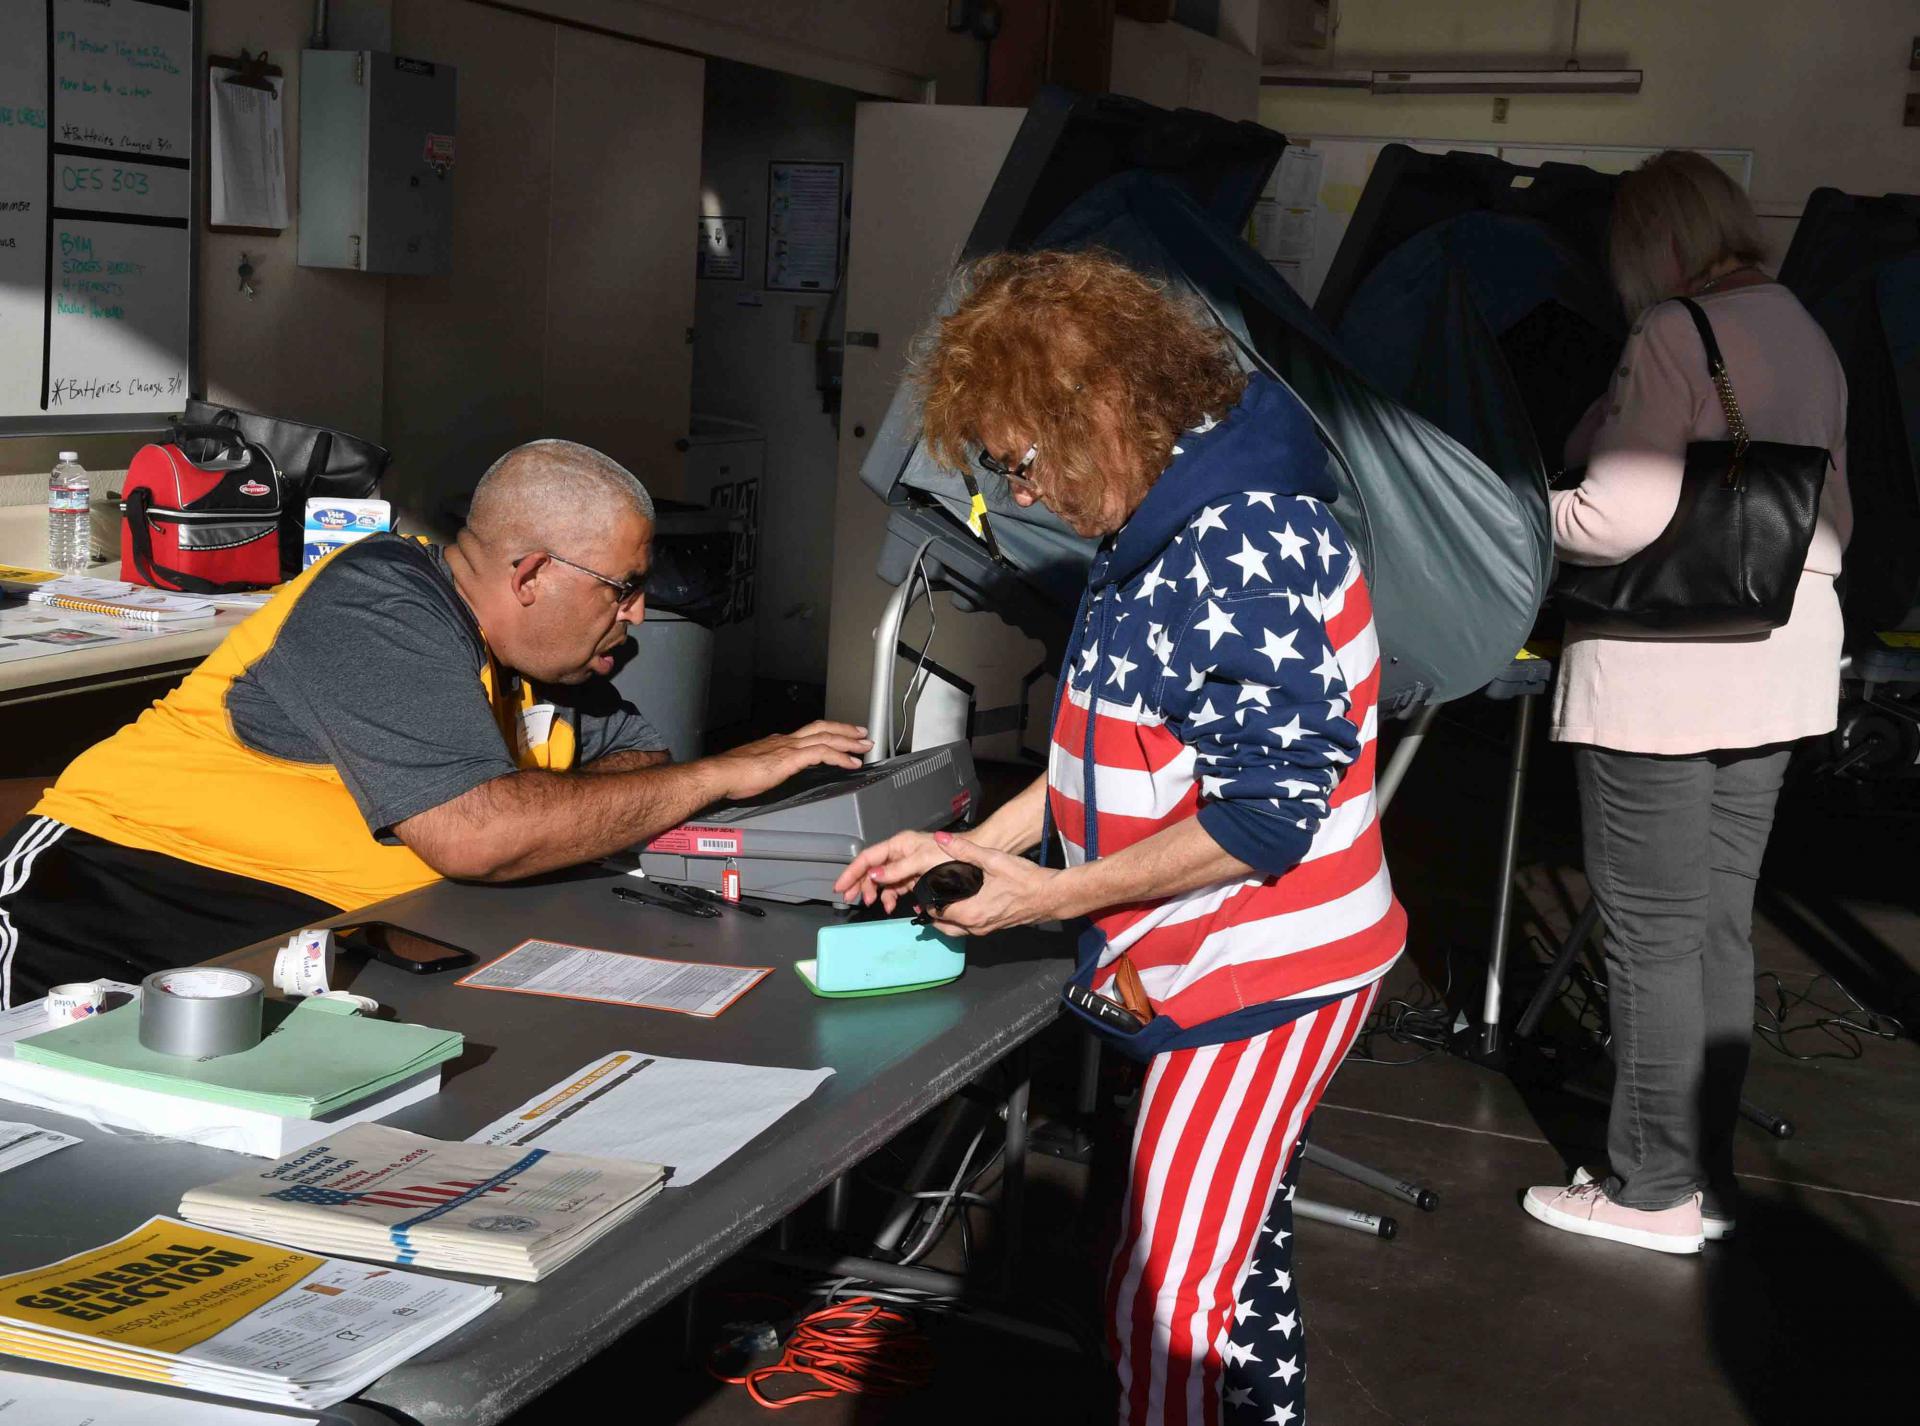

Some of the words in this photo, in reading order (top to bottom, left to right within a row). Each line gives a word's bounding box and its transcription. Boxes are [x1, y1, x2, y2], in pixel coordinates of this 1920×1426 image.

[112, 168, 149, 195] 303
[320, 516, 348, 525] Wipes
[327, 511, 345, 519] Wet
[304, 955, 312, 978] Voted
[55, 999, 77, 1008] Voted
[497, 1122, 526, 1135] Voters
[260, 1145, 331, 1179] California
[280, 1155, 338, 1183] General
[300, 1159, 359, 1186] Election
[340, 1163, 391, 1192] November
[404, 1148, 429, 1163] 2018
[322, 1169, 369, 1189] Tuesday
[15, 1244, 216, 1309] GENERAL
[53, 1249, 255, 1322] ELECTION
[171, 1278, 252, 1313] NOVEMBER
[273, 1255, 305, 1272] 2018
[150, 1318, 178, 1330] Polls
[179, 1309, 203, 1321] open
